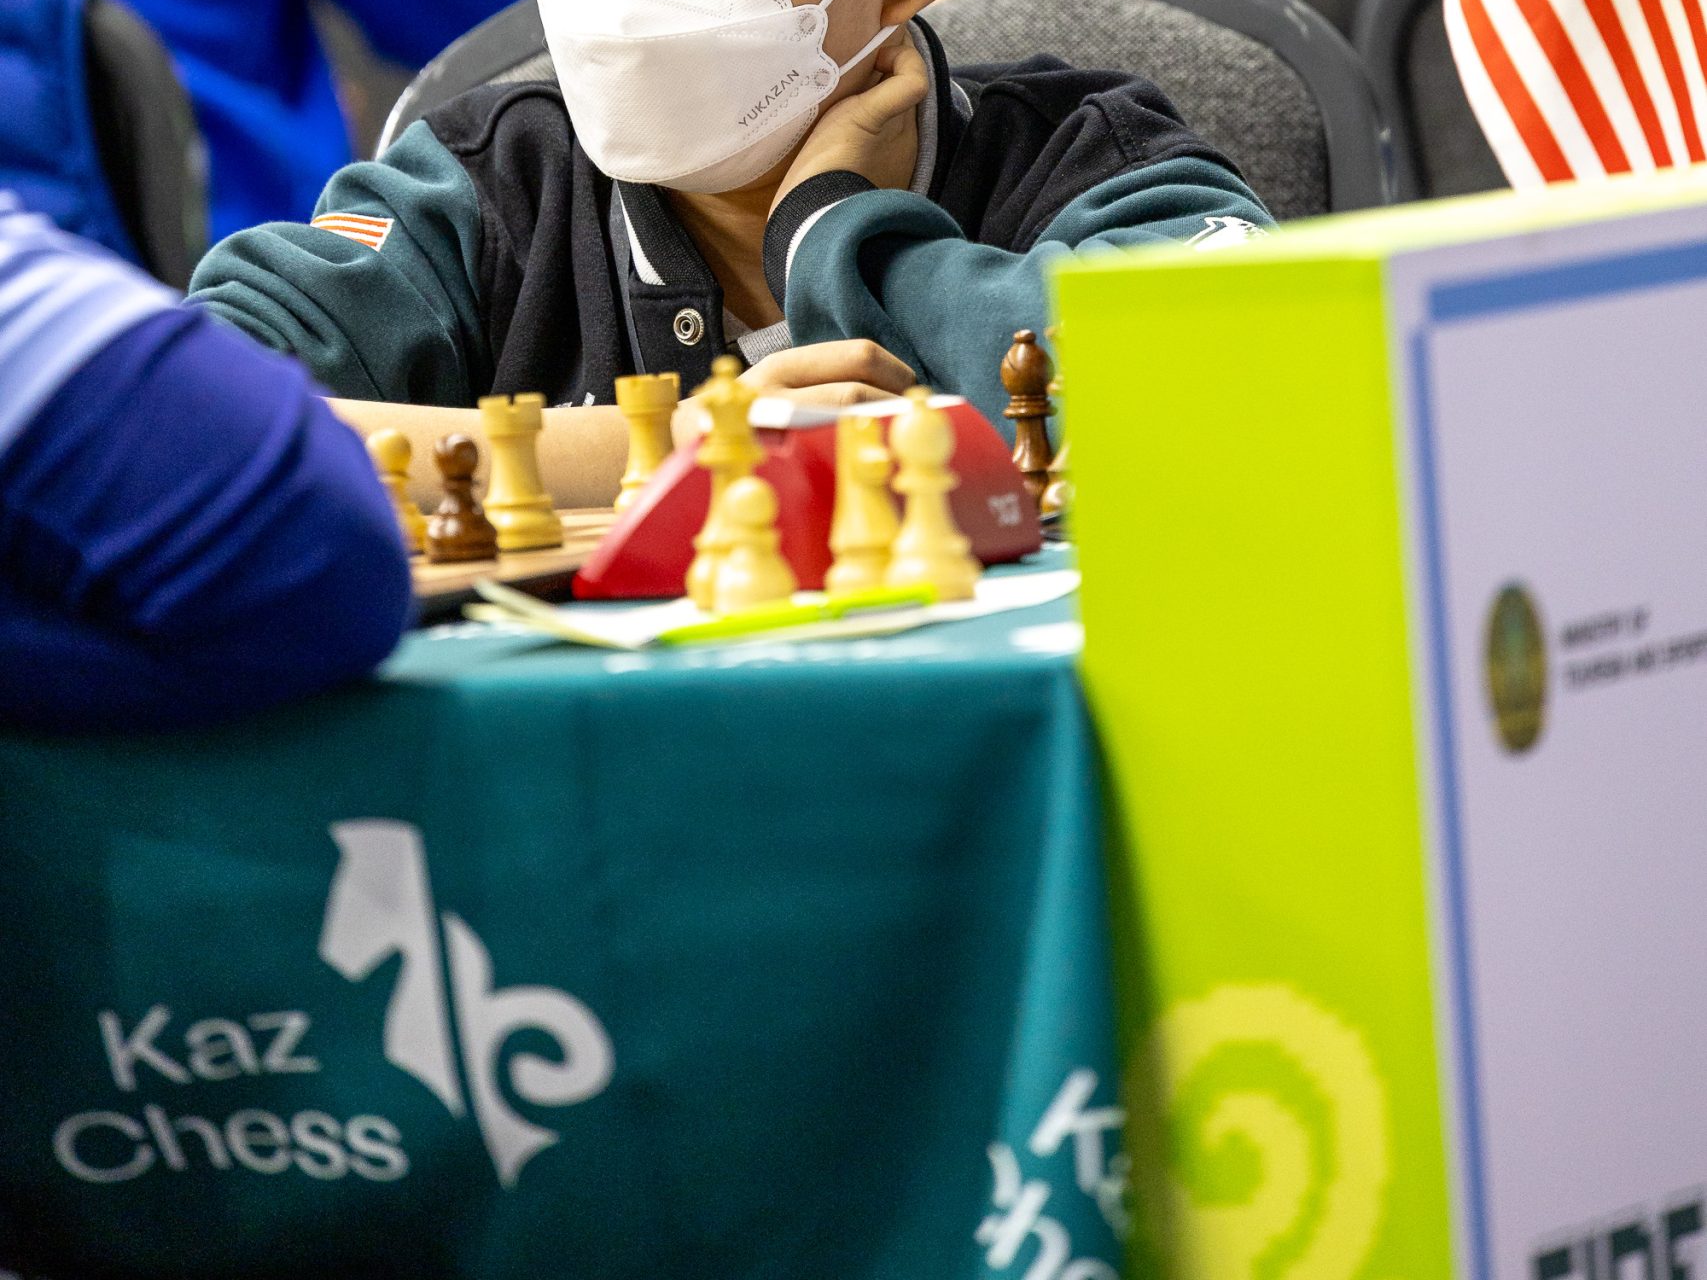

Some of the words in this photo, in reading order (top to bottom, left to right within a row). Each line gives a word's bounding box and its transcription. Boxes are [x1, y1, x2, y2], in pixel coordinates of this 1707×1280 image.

[738, 69, 800, 127] YUKAZAN
[99, 1004, 322, 1093] Kaz
[53, 1104, 409, 1183] Chess
